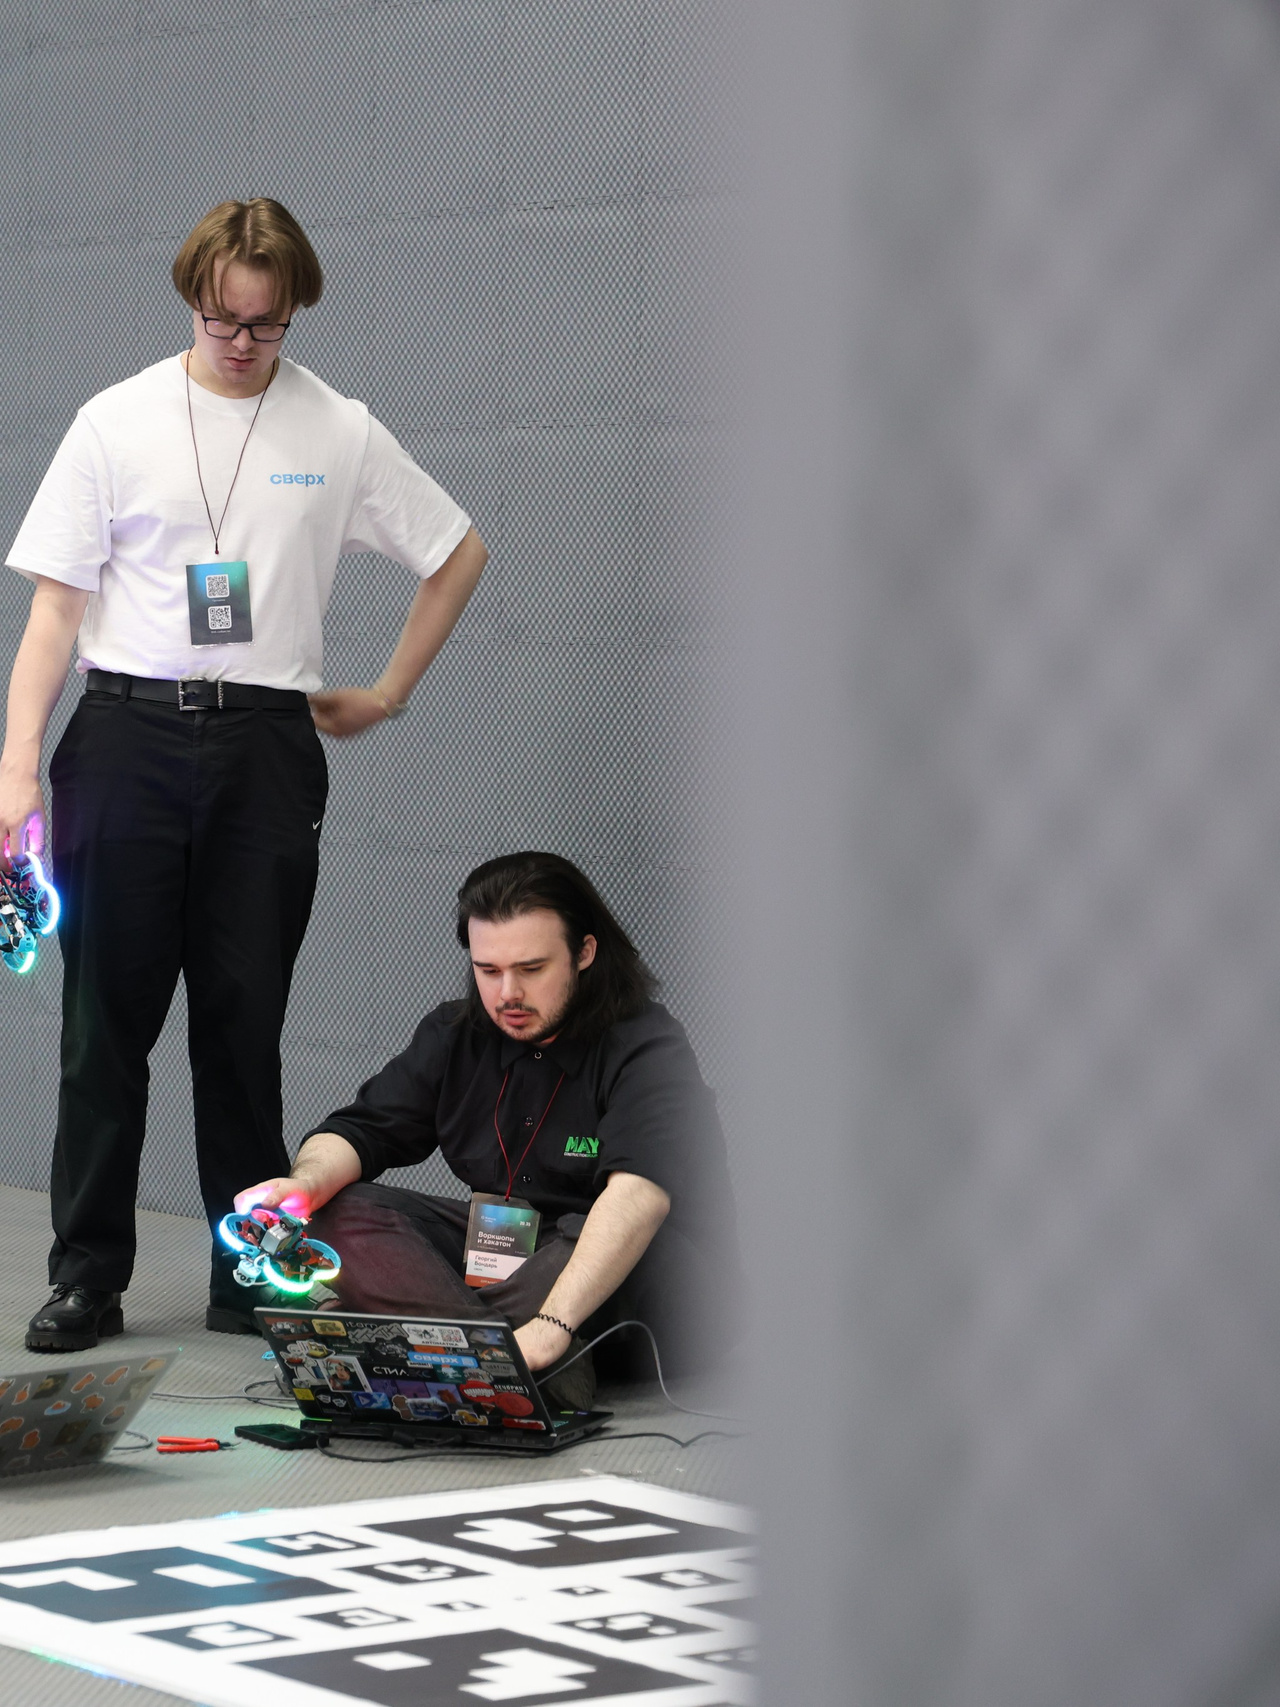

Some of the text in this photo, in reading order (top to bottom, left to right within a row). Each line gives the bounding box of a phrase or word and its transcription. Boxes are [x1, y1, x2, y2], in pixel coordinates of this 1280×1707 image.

[270, 473, 326, 487] сверх
[565, 1136, 599, 1153] MAY
[478, 1231, 515, 1242] Воркшопы
[483, 1239, 511, 1248] хакатон
[413, 1354, 459, 1363] сверх
